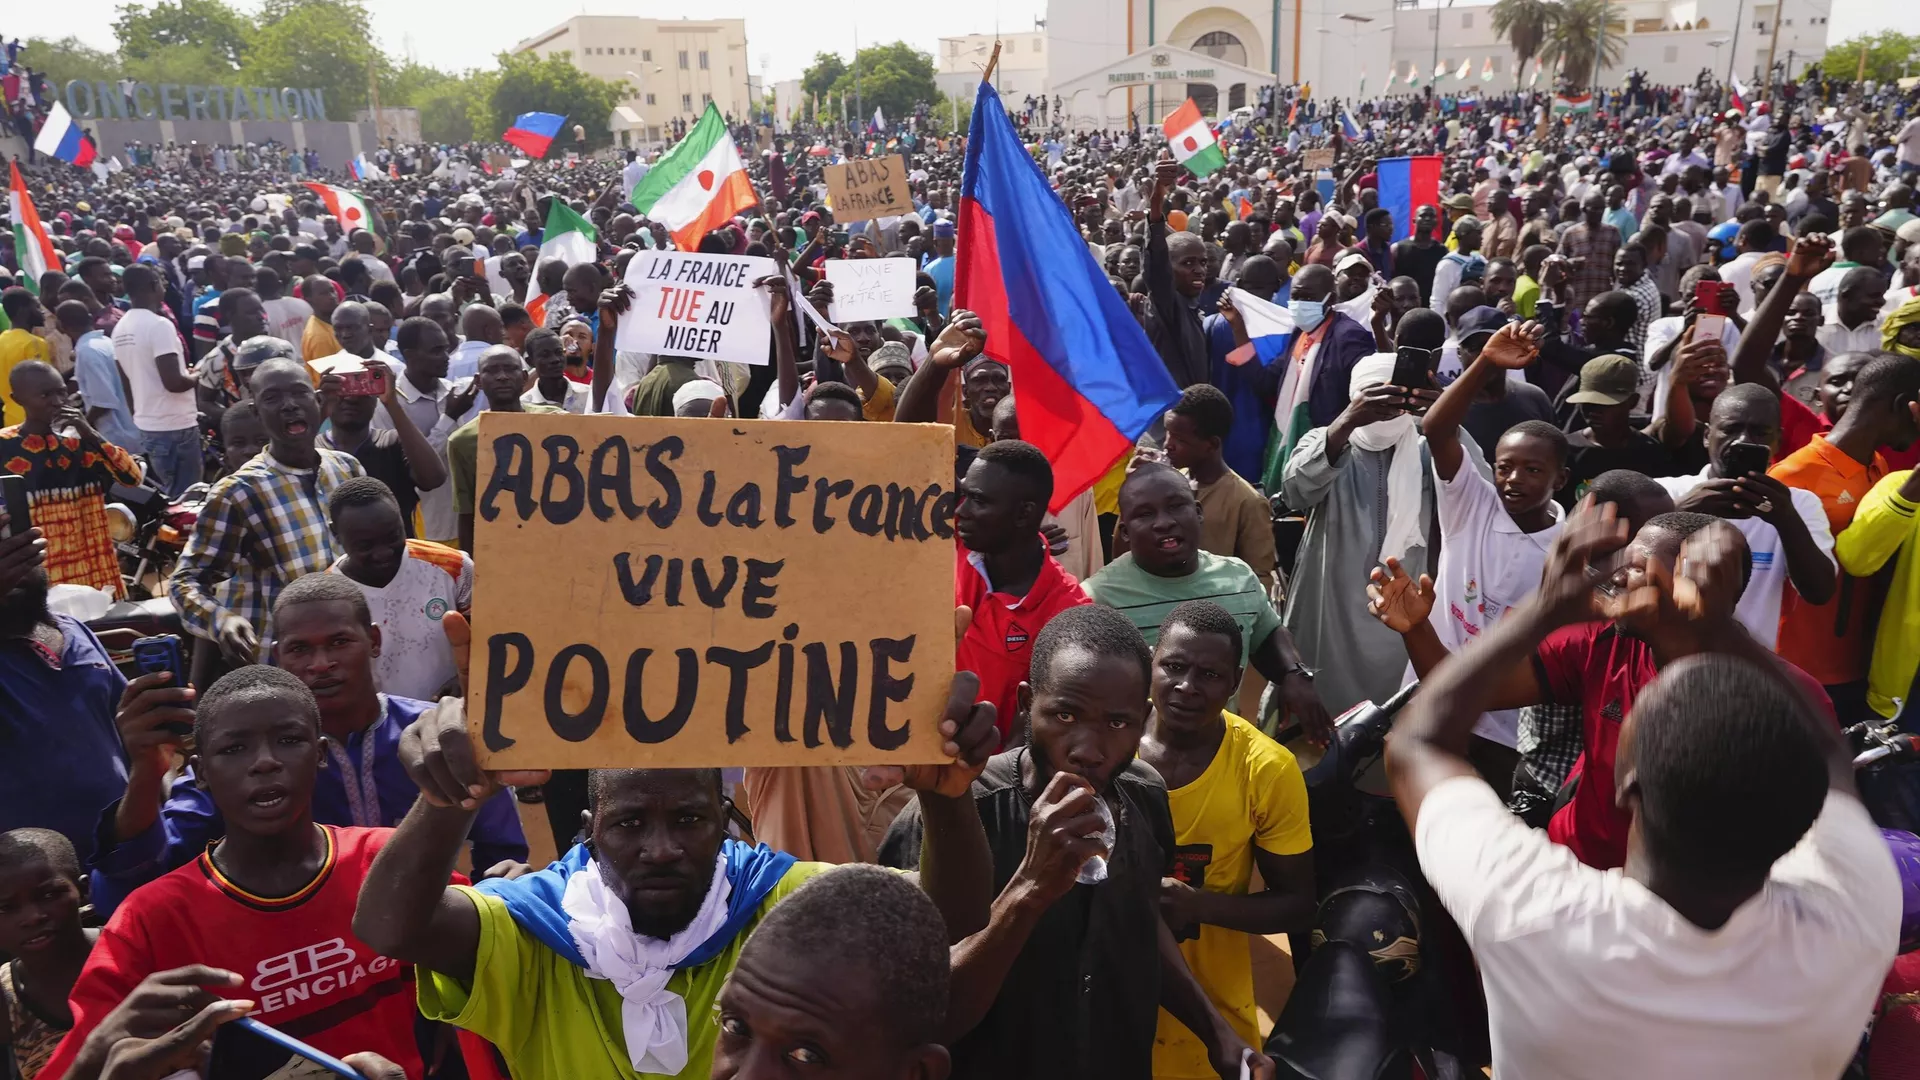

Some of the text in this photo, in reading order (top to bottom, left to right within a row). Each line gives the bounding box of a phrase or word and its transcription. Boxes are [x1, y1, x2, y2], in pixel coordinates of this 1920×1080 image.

[1154, 71, 1177, 80] TRAVAIL
[845, 158, 889, 190] ABAS
[834, 186, 895, 211] LA FRANCE
[647, 258, 750, 288] LA FRANCE
[848, 263, 892, 277] VIVE
[658, 287, 734, 325] TUE AU
[664, 326, 721, 353] NIGER
[480, 433, 957, 542] ABAS la France
[613, 551, 786, 618] VIVE
